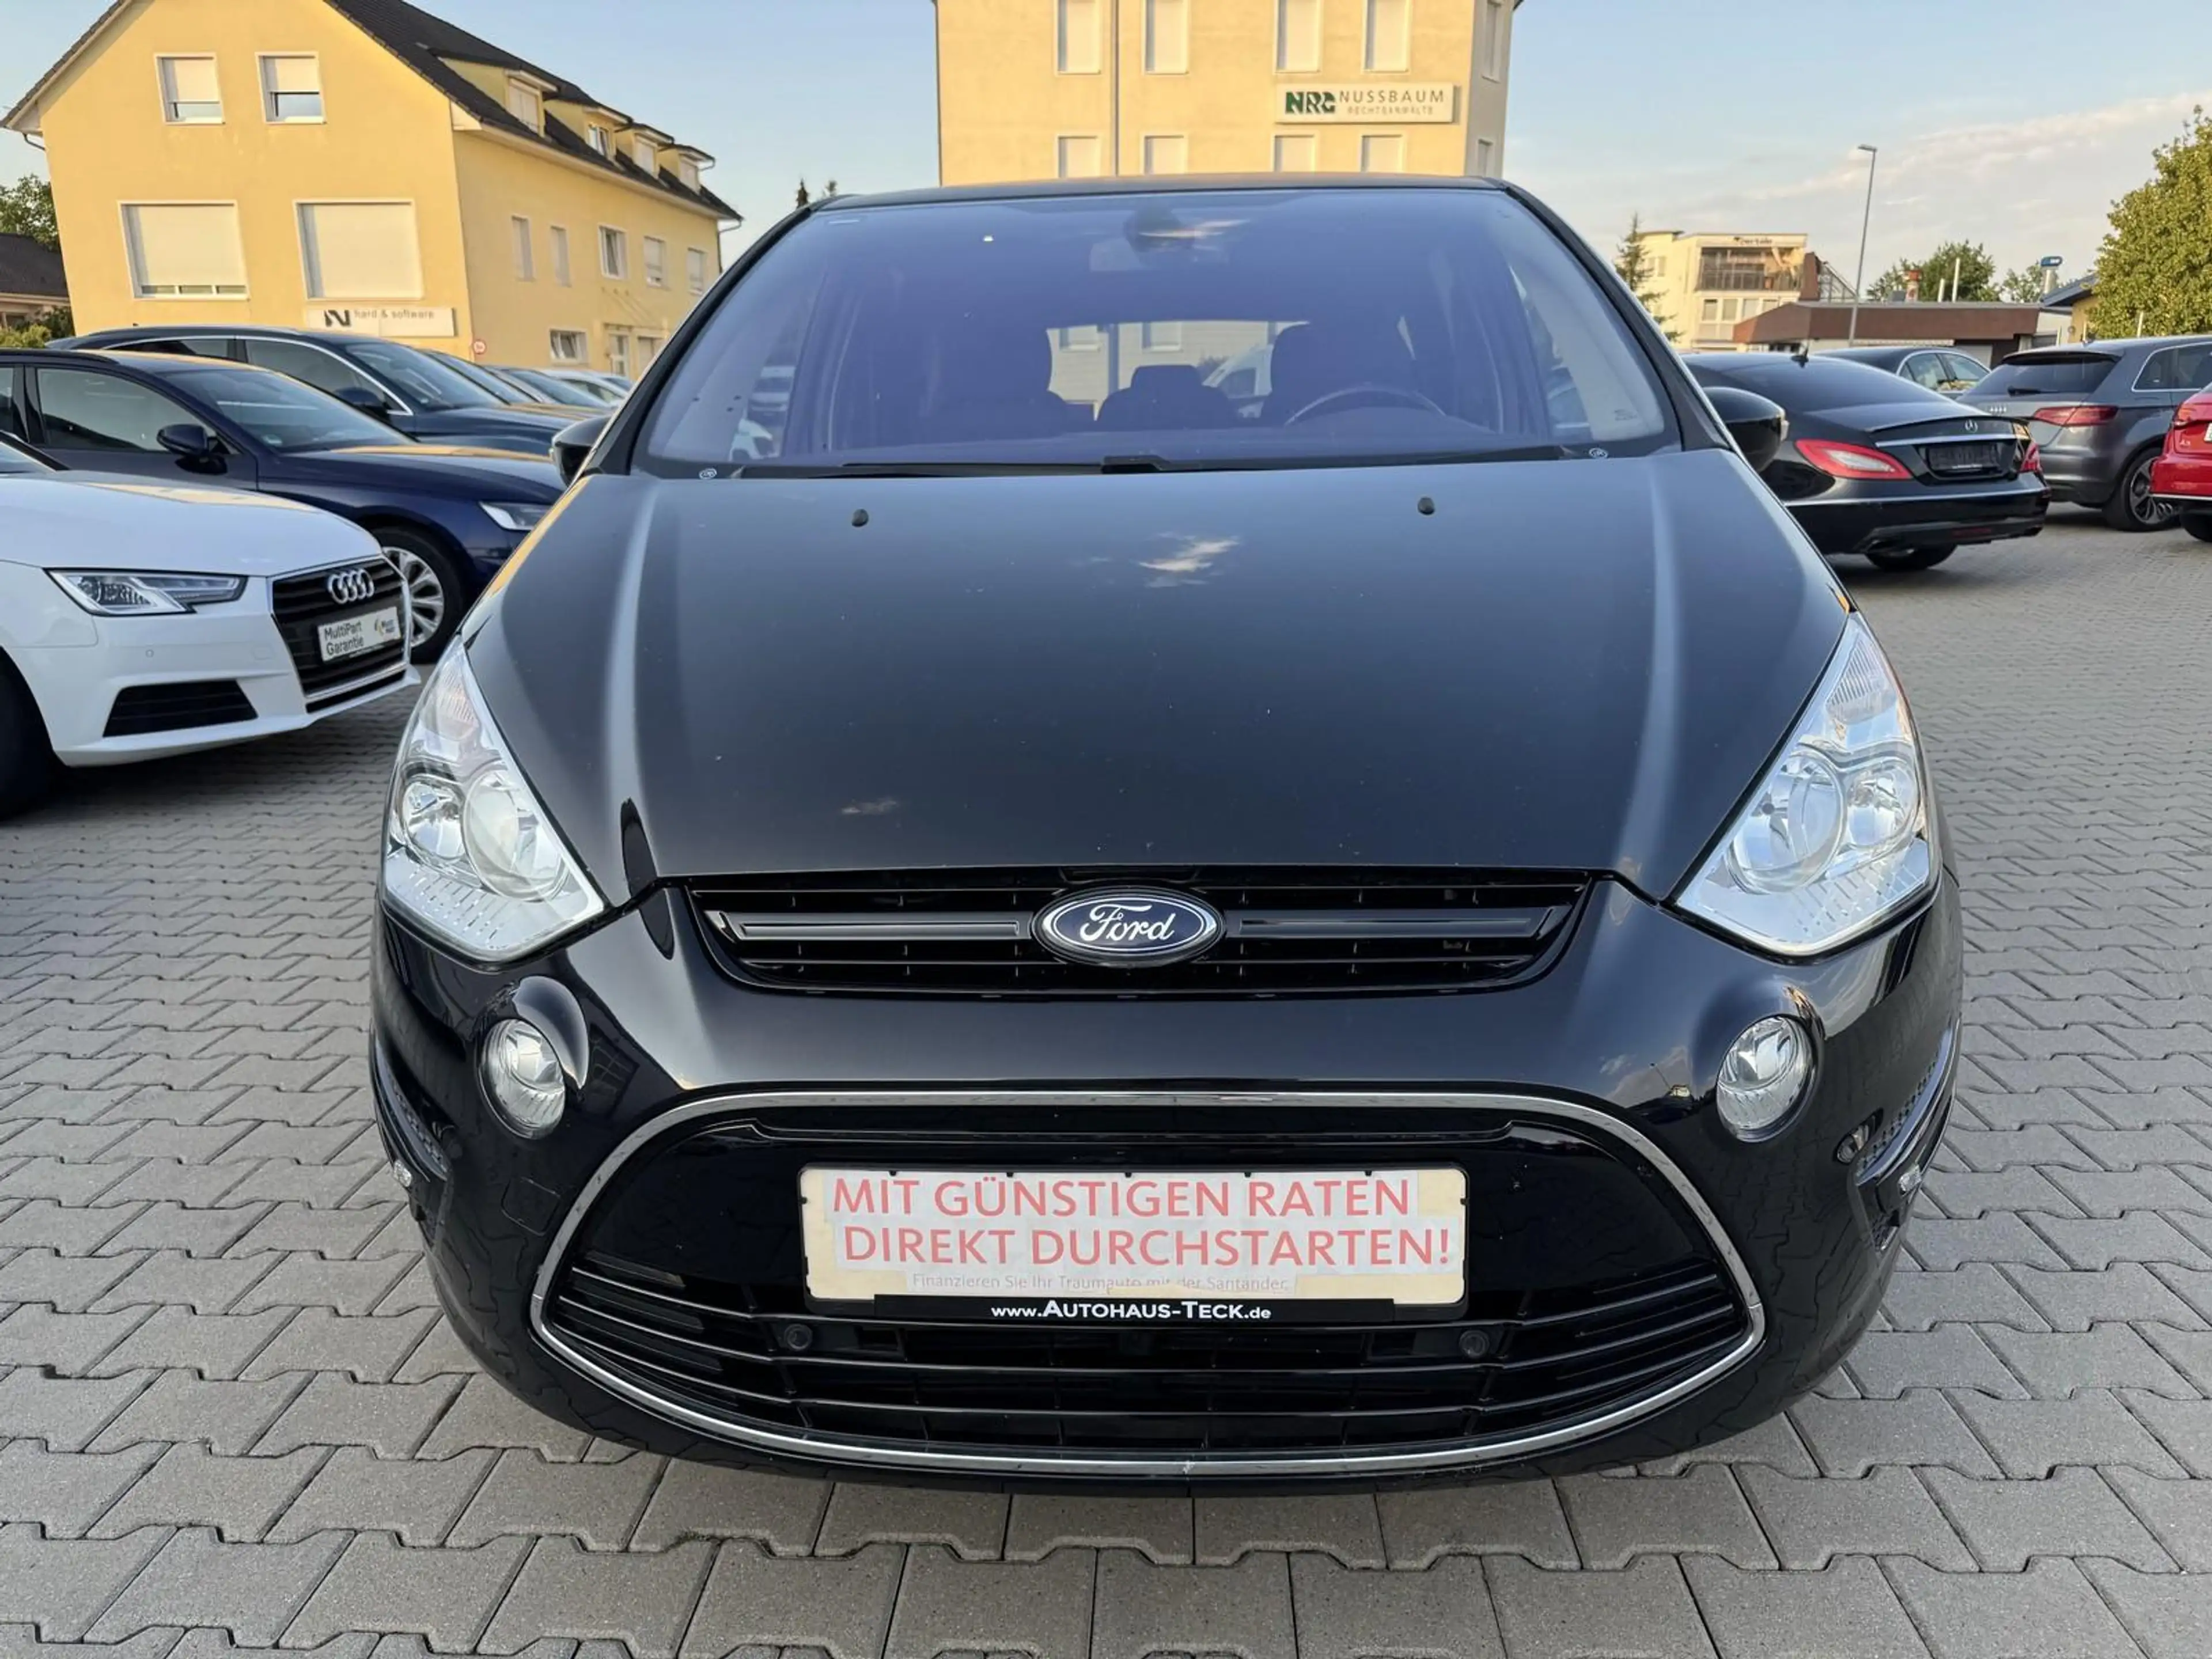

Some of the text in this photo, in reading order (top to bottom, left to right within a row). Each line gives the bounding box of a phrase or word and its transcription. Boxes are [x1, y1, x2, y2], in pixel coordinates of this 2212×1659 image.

[1285, 90, 1444, 115] NRG NUSSBAUM
[354, 309, 377, 319] hard
[381, 309, 388, 319] &
[392, 309, 434, 320] software
[324, 620, 362, 641] MultiPart
[327, 636, 365, 656] Garantie
[1080, 903, 1176, 941] Ford
[833, 1176, 1408, 1217] MIT GÜNSTIGEN RATEN
[844, 1226, 1448, 1266] DIREKT DURCHSTARTEN!
[912, 1273, 1000, 1289] Finanzieren
[1005, 1275, 1027, 1289] Sie
[1033, 1275, 1053, 1289] Ihr
